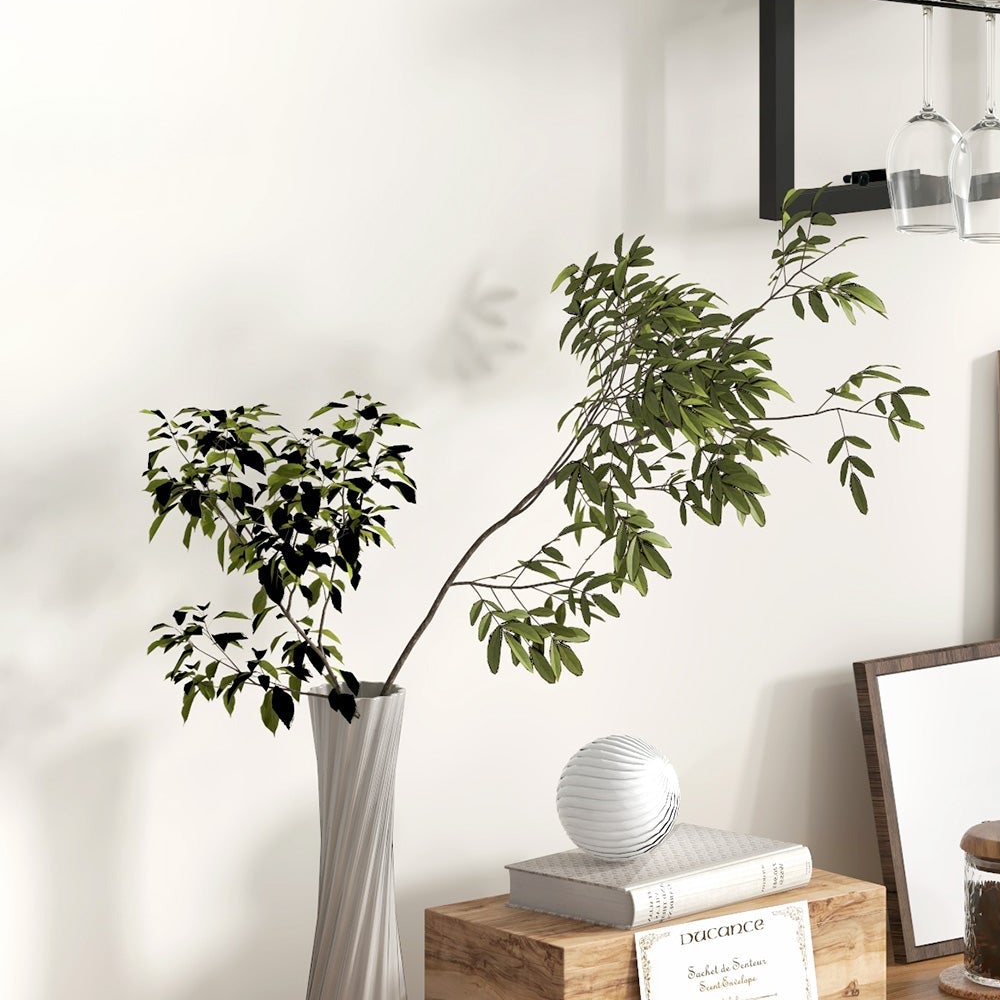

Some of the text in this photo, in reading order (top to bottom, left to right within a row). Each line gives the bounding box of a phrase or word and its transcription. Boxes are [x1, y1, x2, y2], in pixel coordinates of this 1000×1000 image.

[687, 957, 768, 980] Sachet de Senteur
[699, 974, 758, 993] Scent Envelope
